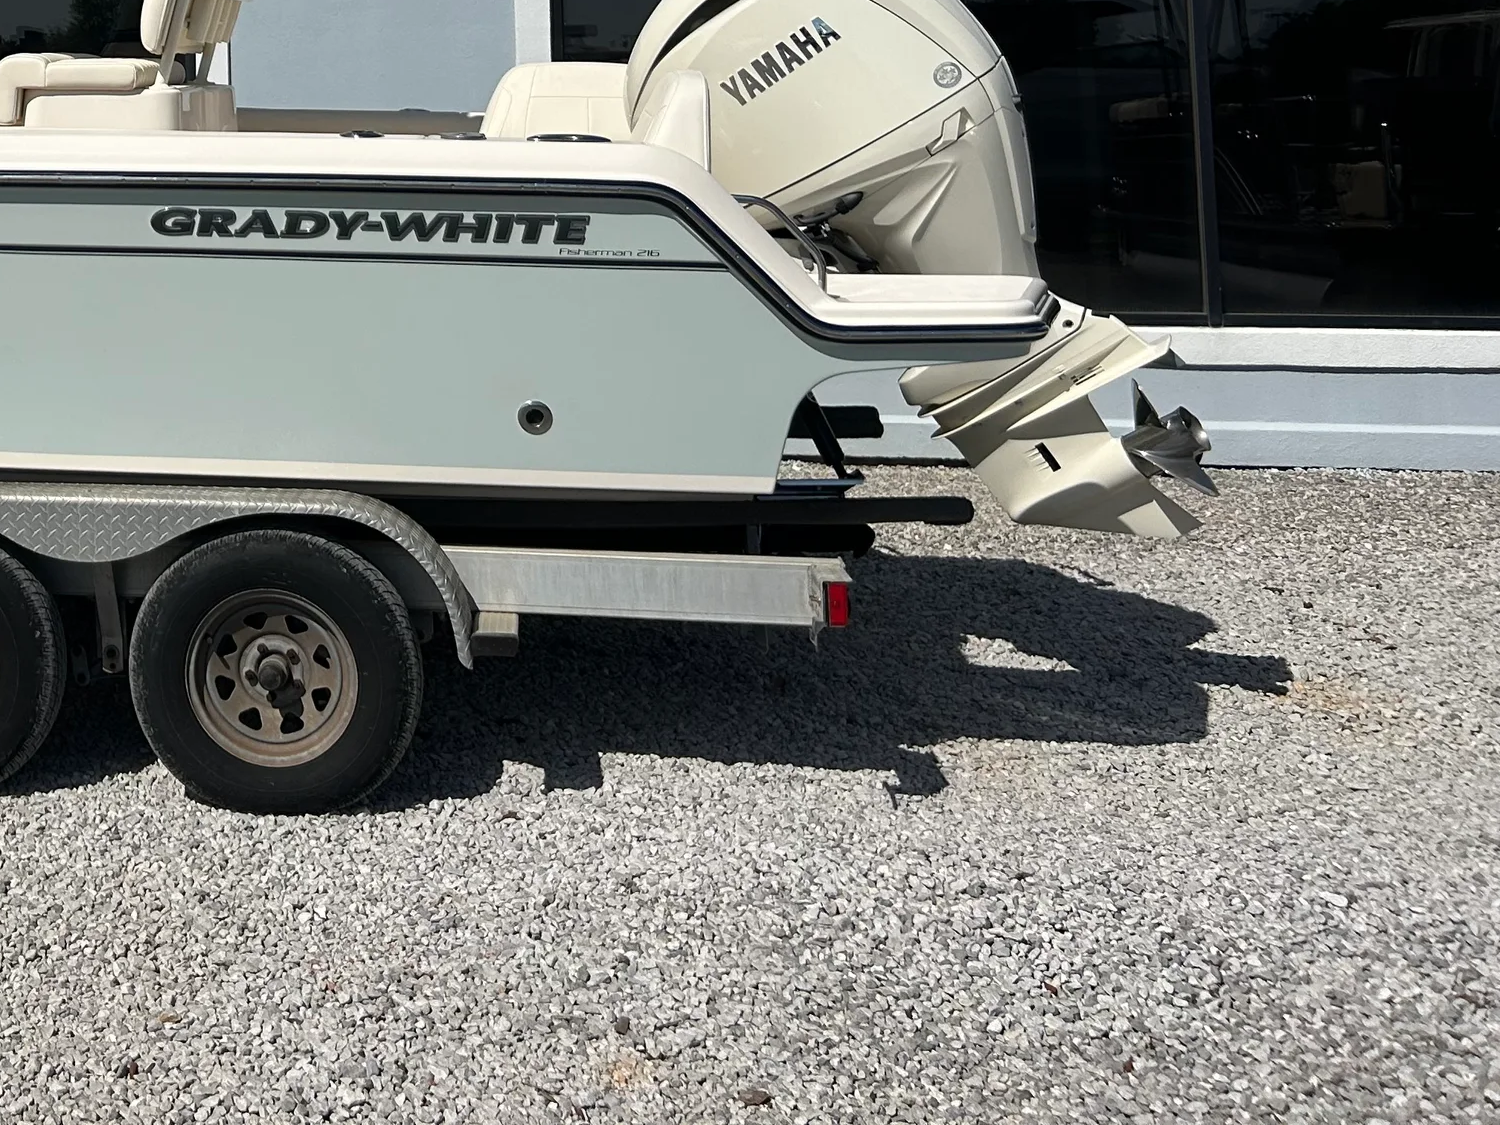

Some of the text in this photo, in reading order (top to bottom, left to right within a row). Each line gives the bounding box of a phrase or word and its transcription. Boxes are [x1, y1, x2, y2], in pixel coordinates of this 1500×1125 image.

[719, 16, 842, 107] YAMAHA
[150, 207, 591, 245] GRADY-WHITE
[559, 248, 660, 257] Fisherman 216
